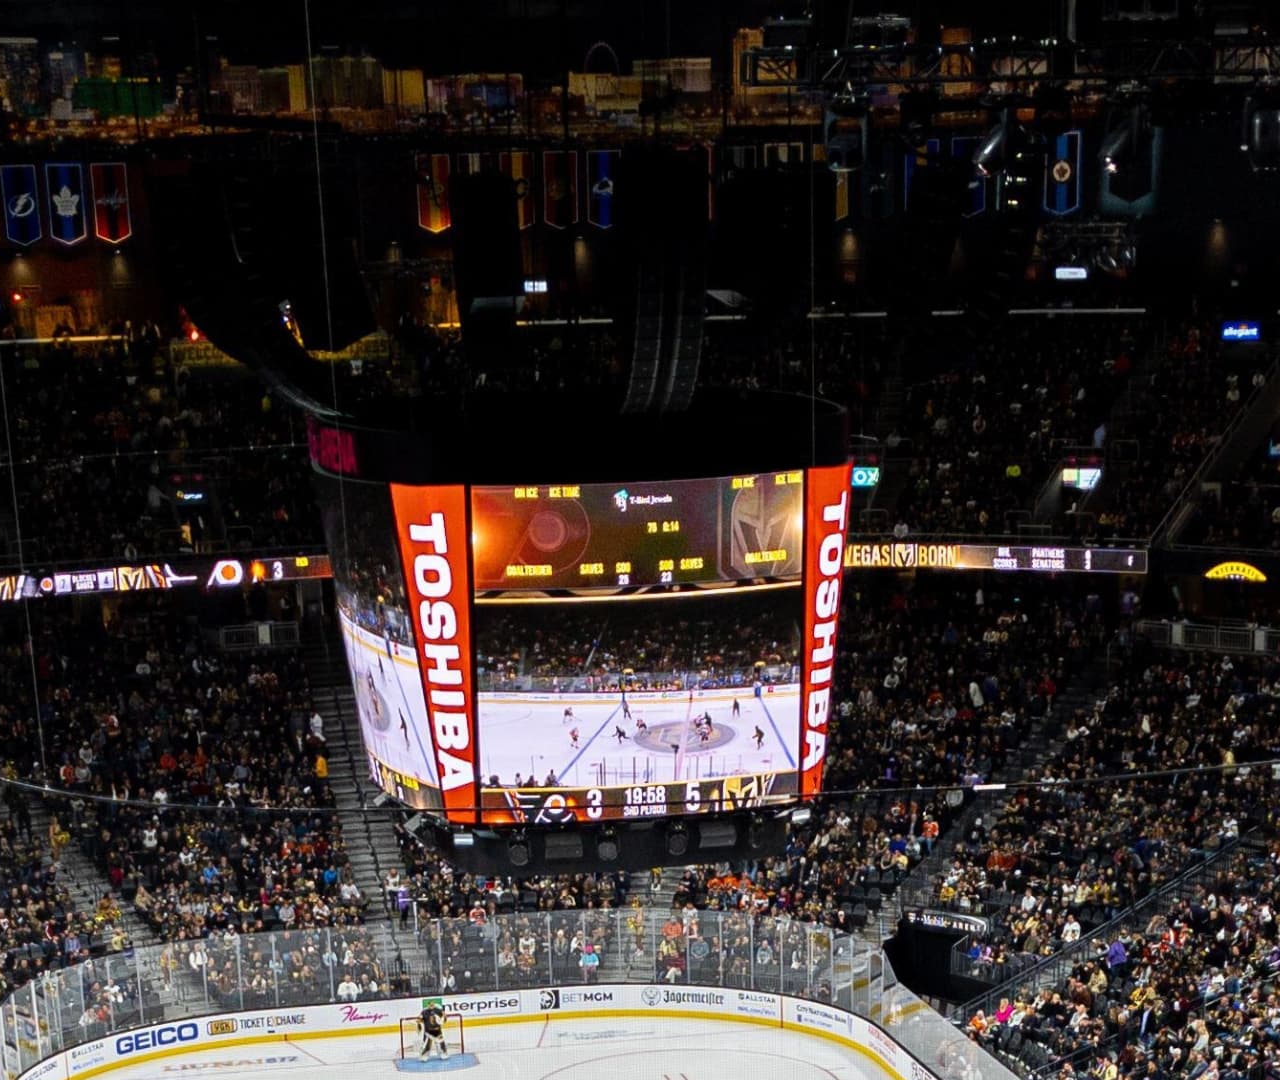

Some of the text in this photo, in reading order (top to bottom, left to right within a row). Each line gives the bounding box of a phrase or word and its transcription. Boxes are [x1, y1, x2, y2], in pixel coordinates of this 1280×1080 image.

[680, 557, 703, 570] SAVES
[844, 545, 957, 567] VEGAS BORN
[1032, 558, 1065, 569] SENATORS
[273, 561, 283, 578] 3
[506, 564, 552, 576] GOALTENDER
[580, 564, 603, 575] SAVES
[803, 490, 848, 772] TOSHIBA
[409, 512, 475, 791] TOSHIBA
[587, 781, 700, 817] 3 19:58 5
[562, 991, 613, 1003] BETMGM
[340, 1005, 383, 1023] Flamingo
[240, 1017, 265, 1029] TICKET
[116, 1023, 198, 1055] GEICO
